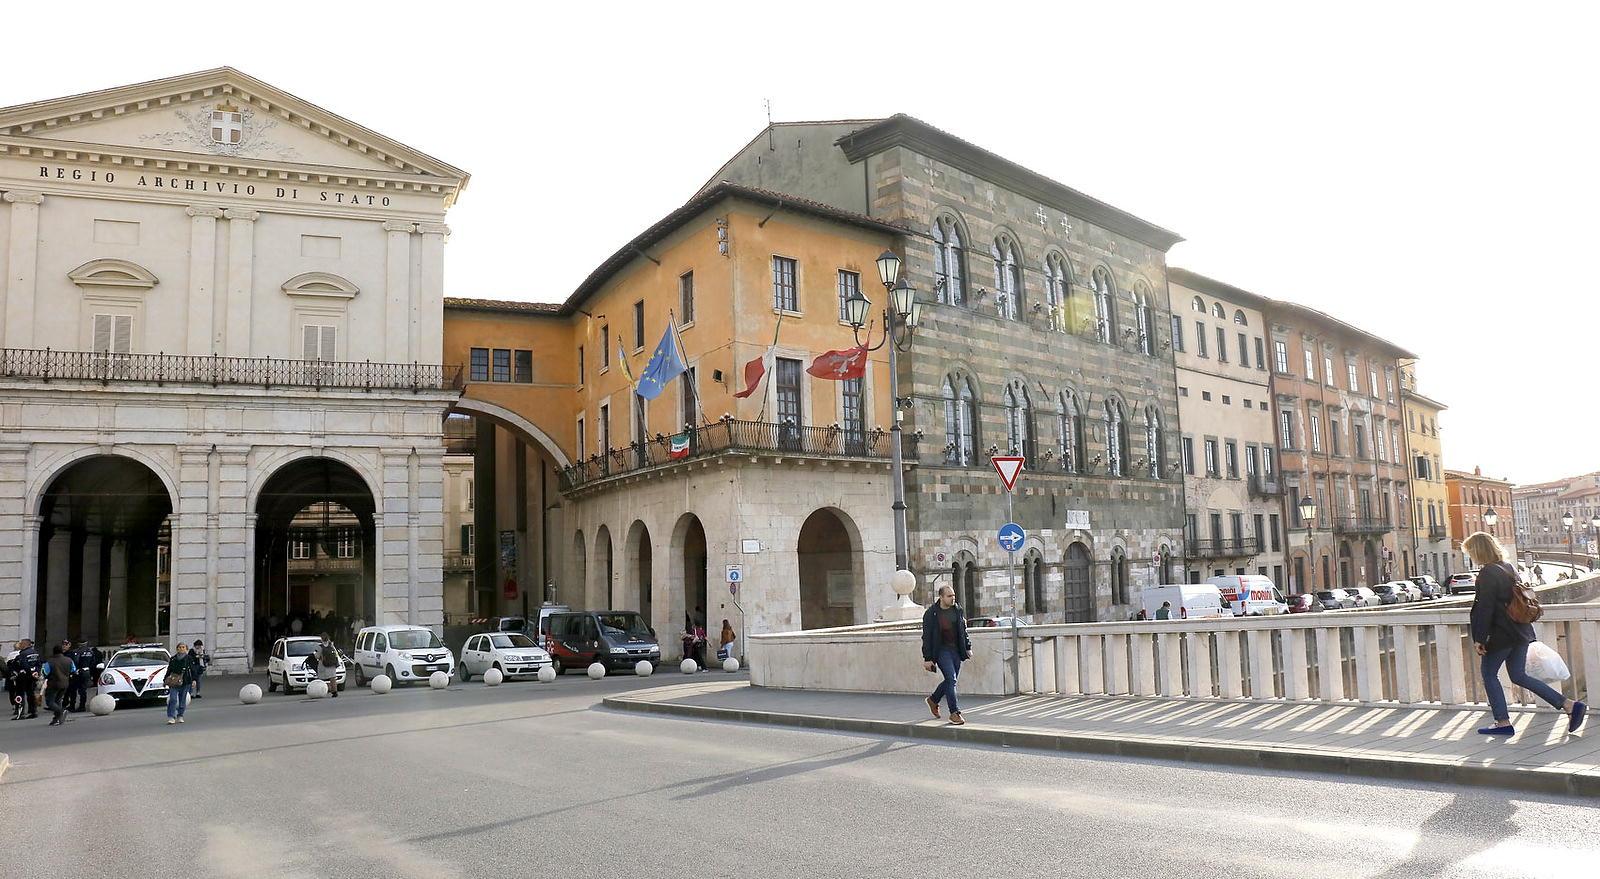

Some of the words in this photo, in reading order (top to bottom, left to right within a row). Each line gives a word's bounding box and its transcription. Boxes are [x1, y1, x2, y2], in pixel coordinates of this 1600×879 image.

[40, 166, 115, 183] REGIO
[138, 175, 255, 196] ARCHIVIO
[276, 187, 298, 199] DI
[320, 191, 390, 207] STATO
[1250, 590, 1273, 600] MORINI
